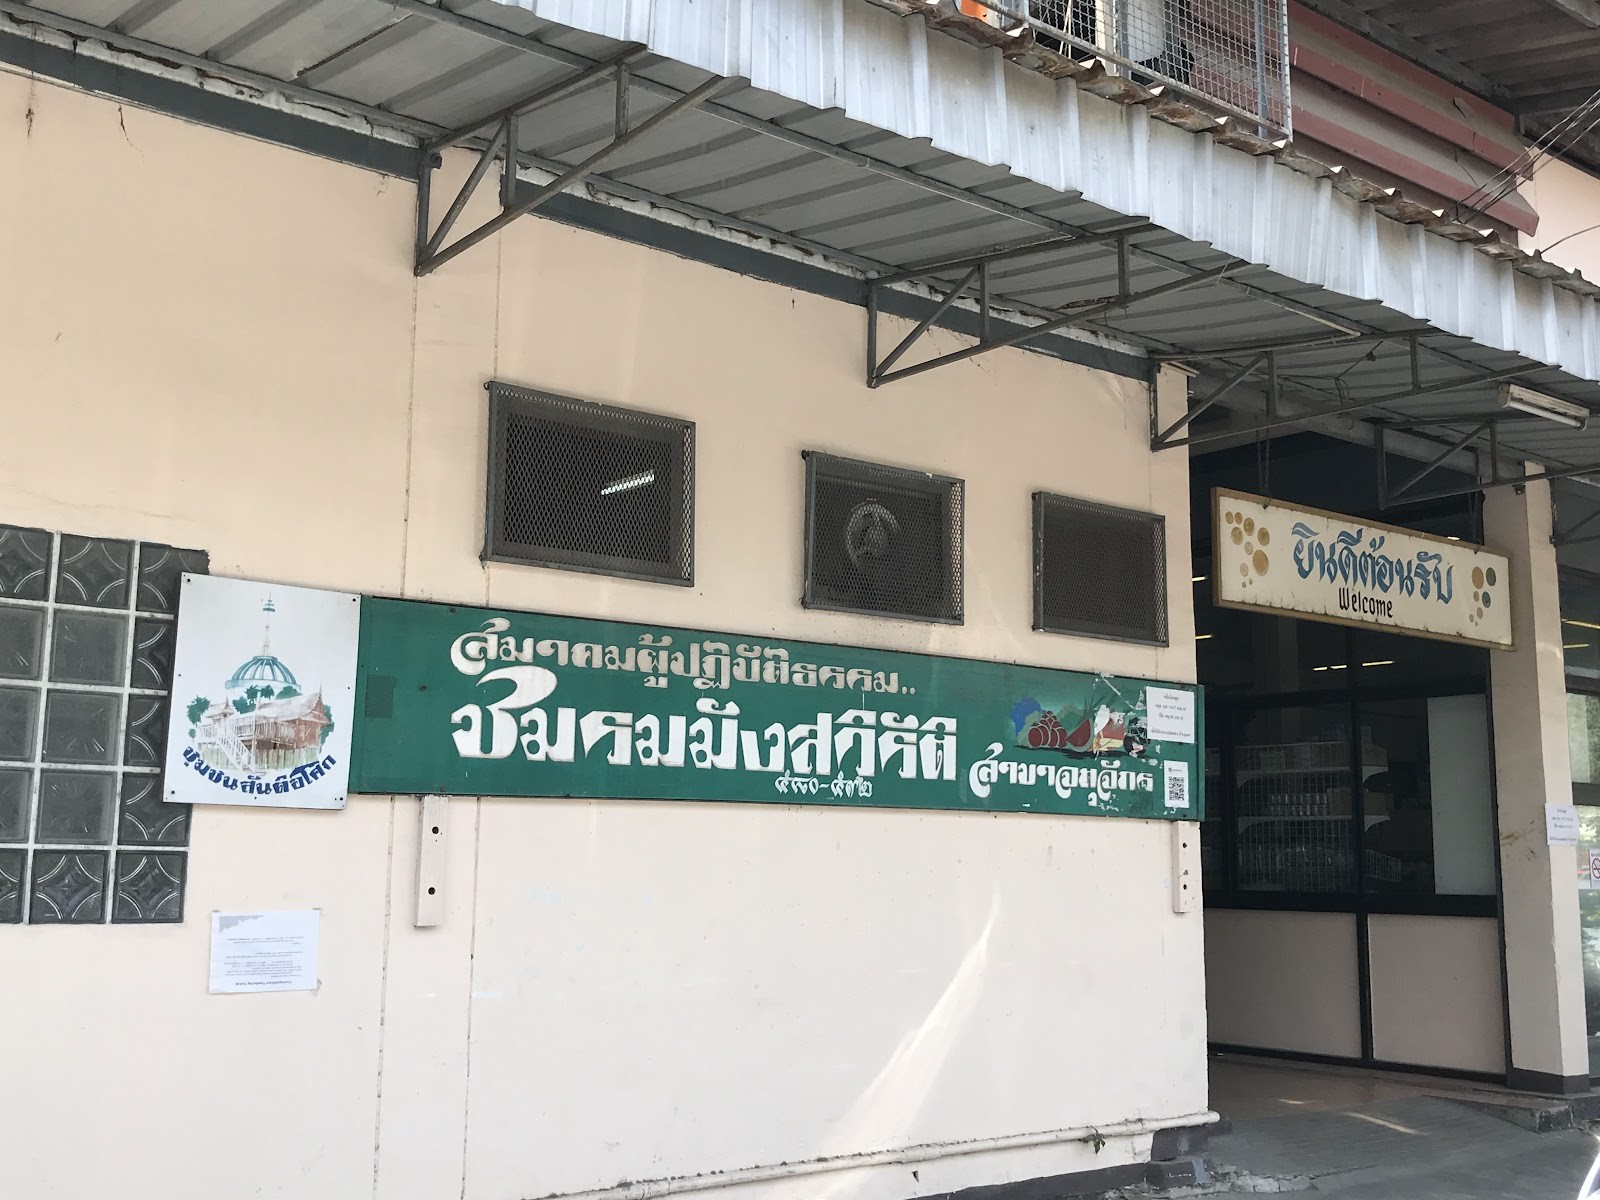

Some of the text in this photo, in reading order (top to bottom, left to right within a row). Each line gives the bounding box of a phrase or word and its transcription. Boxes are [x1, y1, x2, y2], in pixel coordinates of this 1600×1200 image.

[1291, 522, 1453, 605] ยินดีต้อนรับ
[1338, 587, 1394, 618] Welcome
[450, 665, 957, 781] ชมรมมังสวิรัติ
[182, 746, 337, 795] ชุมชนสันติอโศก
[969, 742, 1154, 807] สาขาจตุจักร
